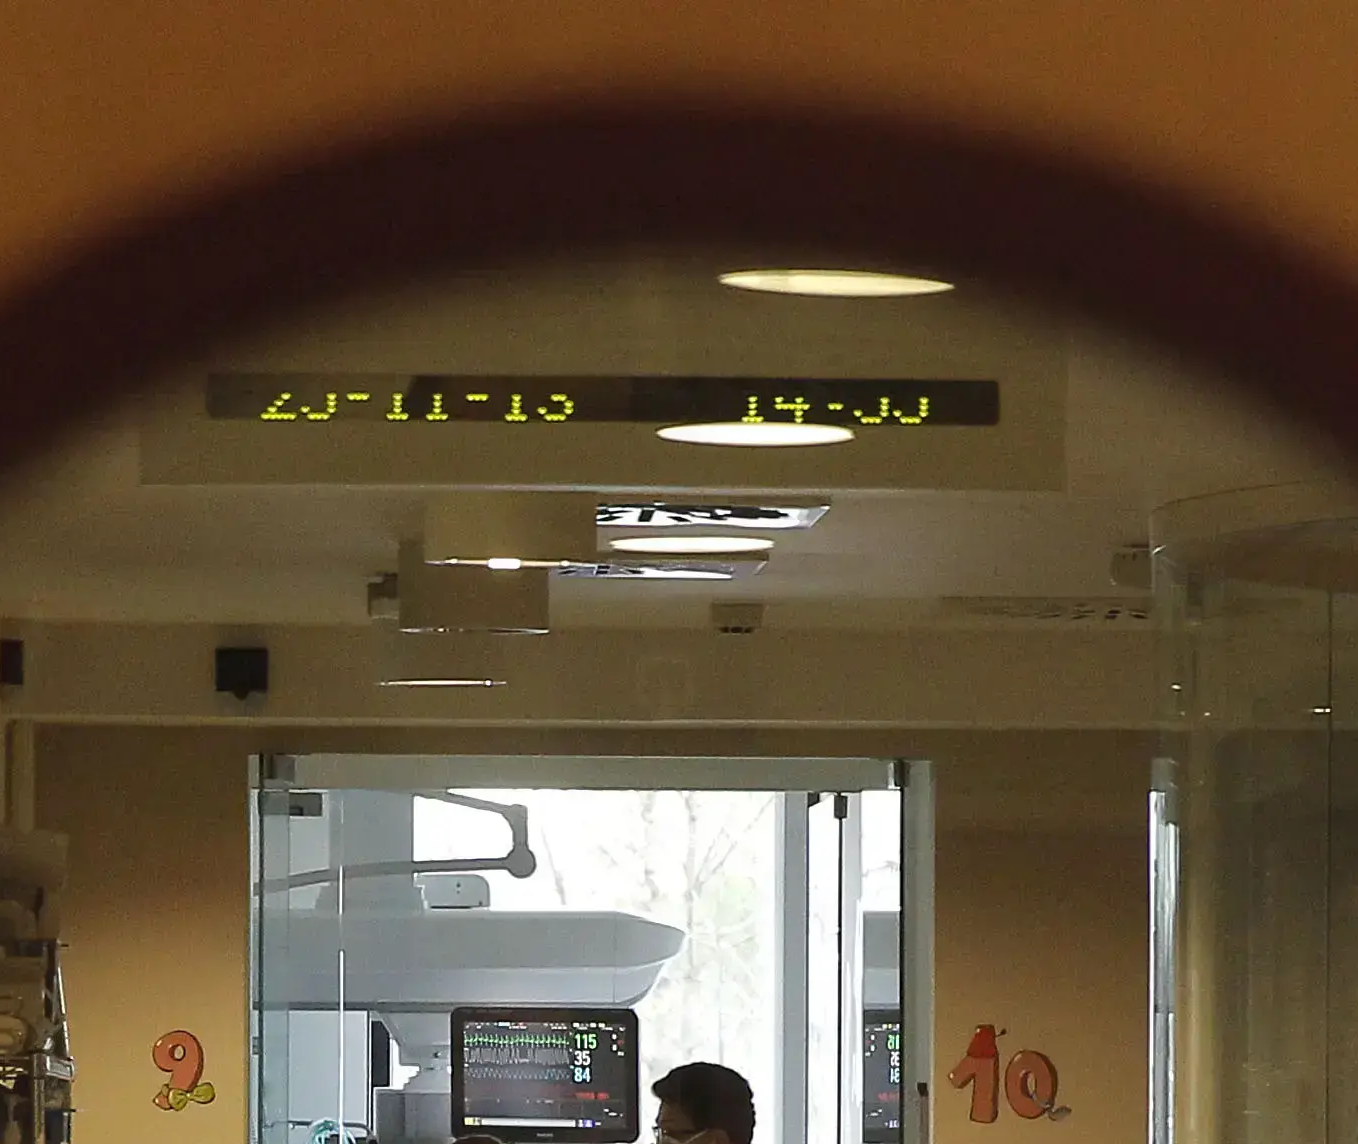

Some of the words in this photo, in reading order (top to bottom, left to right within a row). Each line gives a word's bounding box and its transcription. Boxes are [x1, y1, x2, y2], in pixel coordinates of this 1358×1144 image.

[574, 1033, 598, 1049] 115
[574, 1050, 591, 1066] 35
[152, 1029, 210, 1111] 9
[574, 1067, 591, 1083] 84
[948, 1024, 1058, 1124] 10
